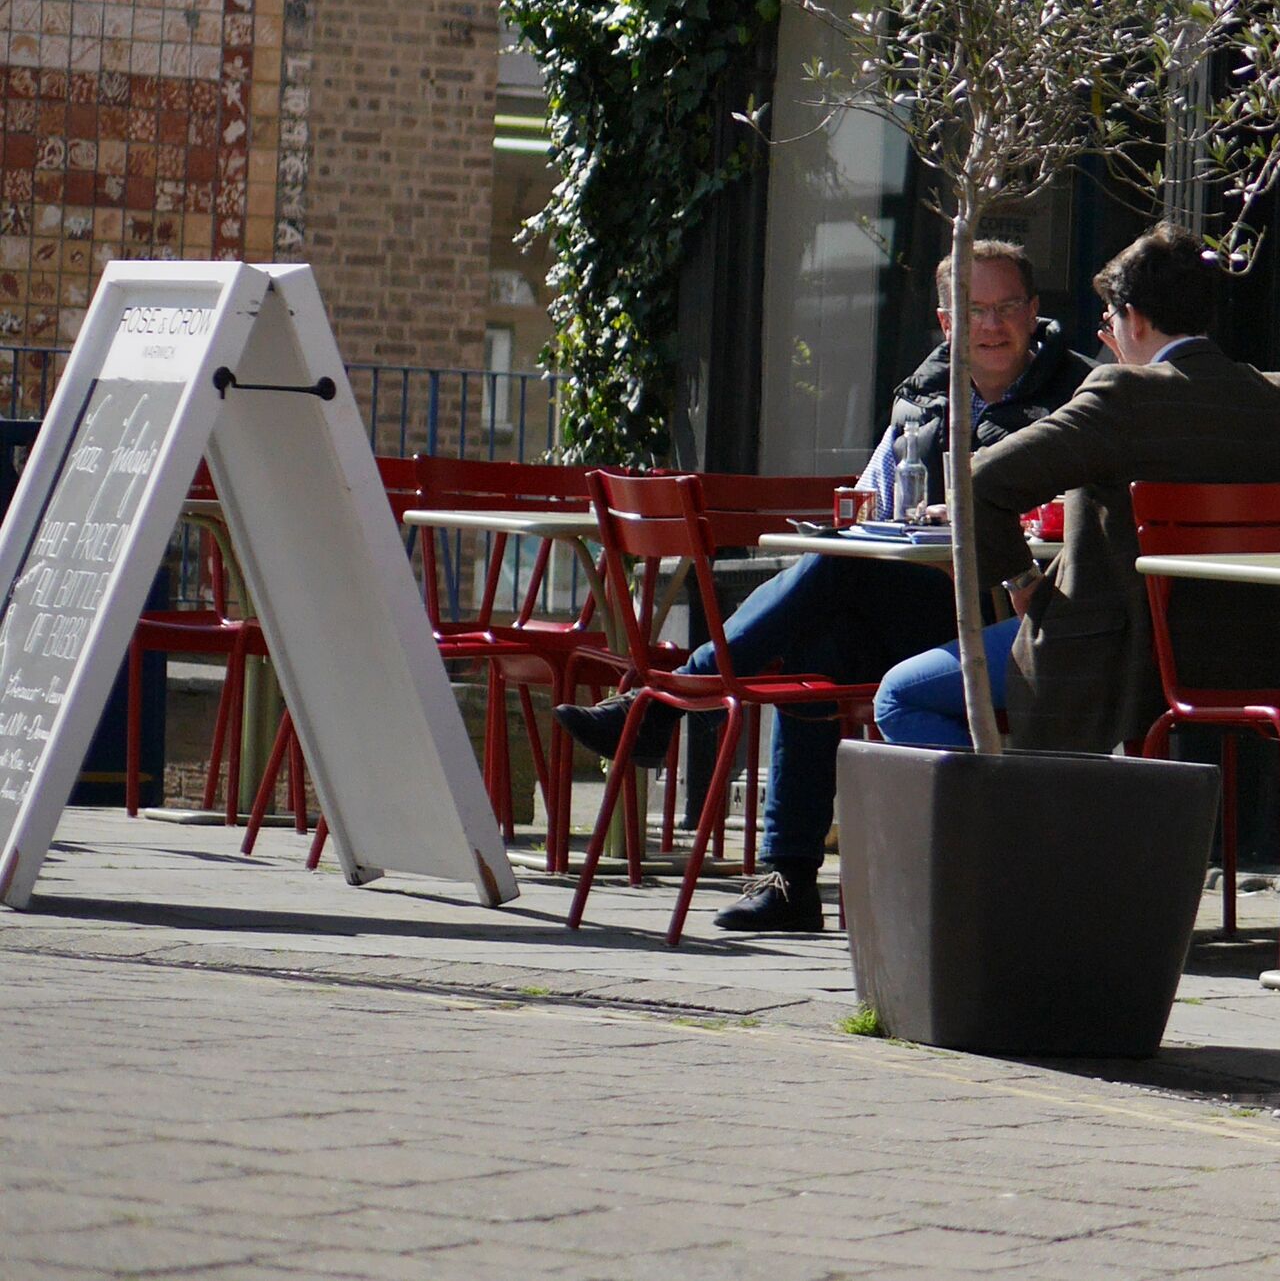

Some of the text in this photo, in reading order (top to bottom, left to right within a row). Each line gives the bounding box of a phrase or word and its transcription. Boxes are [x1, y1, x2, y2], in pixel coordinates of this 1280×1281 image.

[979, 215, 1030, 234] COFFEE
[117, 307, 162, 334] ROSE
[169, 307, 213, 335] CROW
[33, 521, 77, 557] HALF
[71, 522, 118, 561] PRICE
[23, 612, 53, 653] OF
